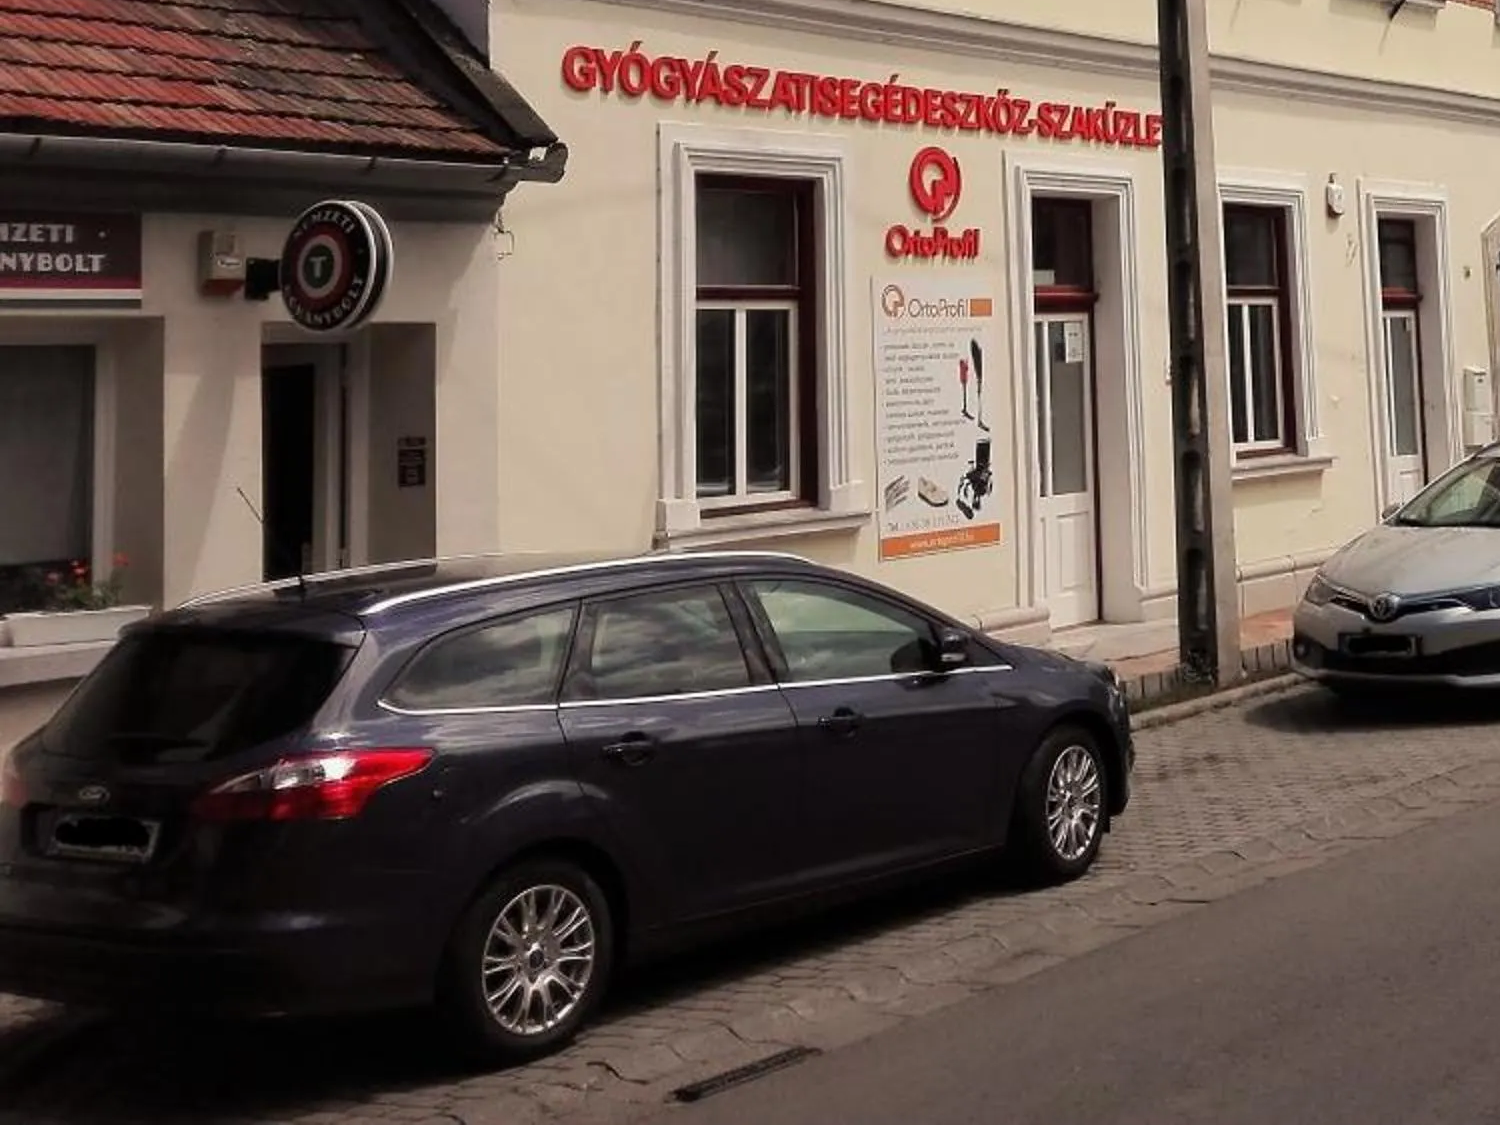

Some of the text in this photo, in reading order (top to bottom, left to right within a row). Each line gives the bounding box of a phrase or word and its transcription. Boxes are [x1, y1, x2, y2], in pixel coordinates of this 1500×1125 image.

[561, 41, 1163, 147] GYÓGYÁSZATISEGÉDESZKÖZ-SZAKÜZLE
[885, 224, 980, 260] OrtoProfil
[309, 256, 328, 279] T
[907, 298, 968, 318] OrtoProfil
